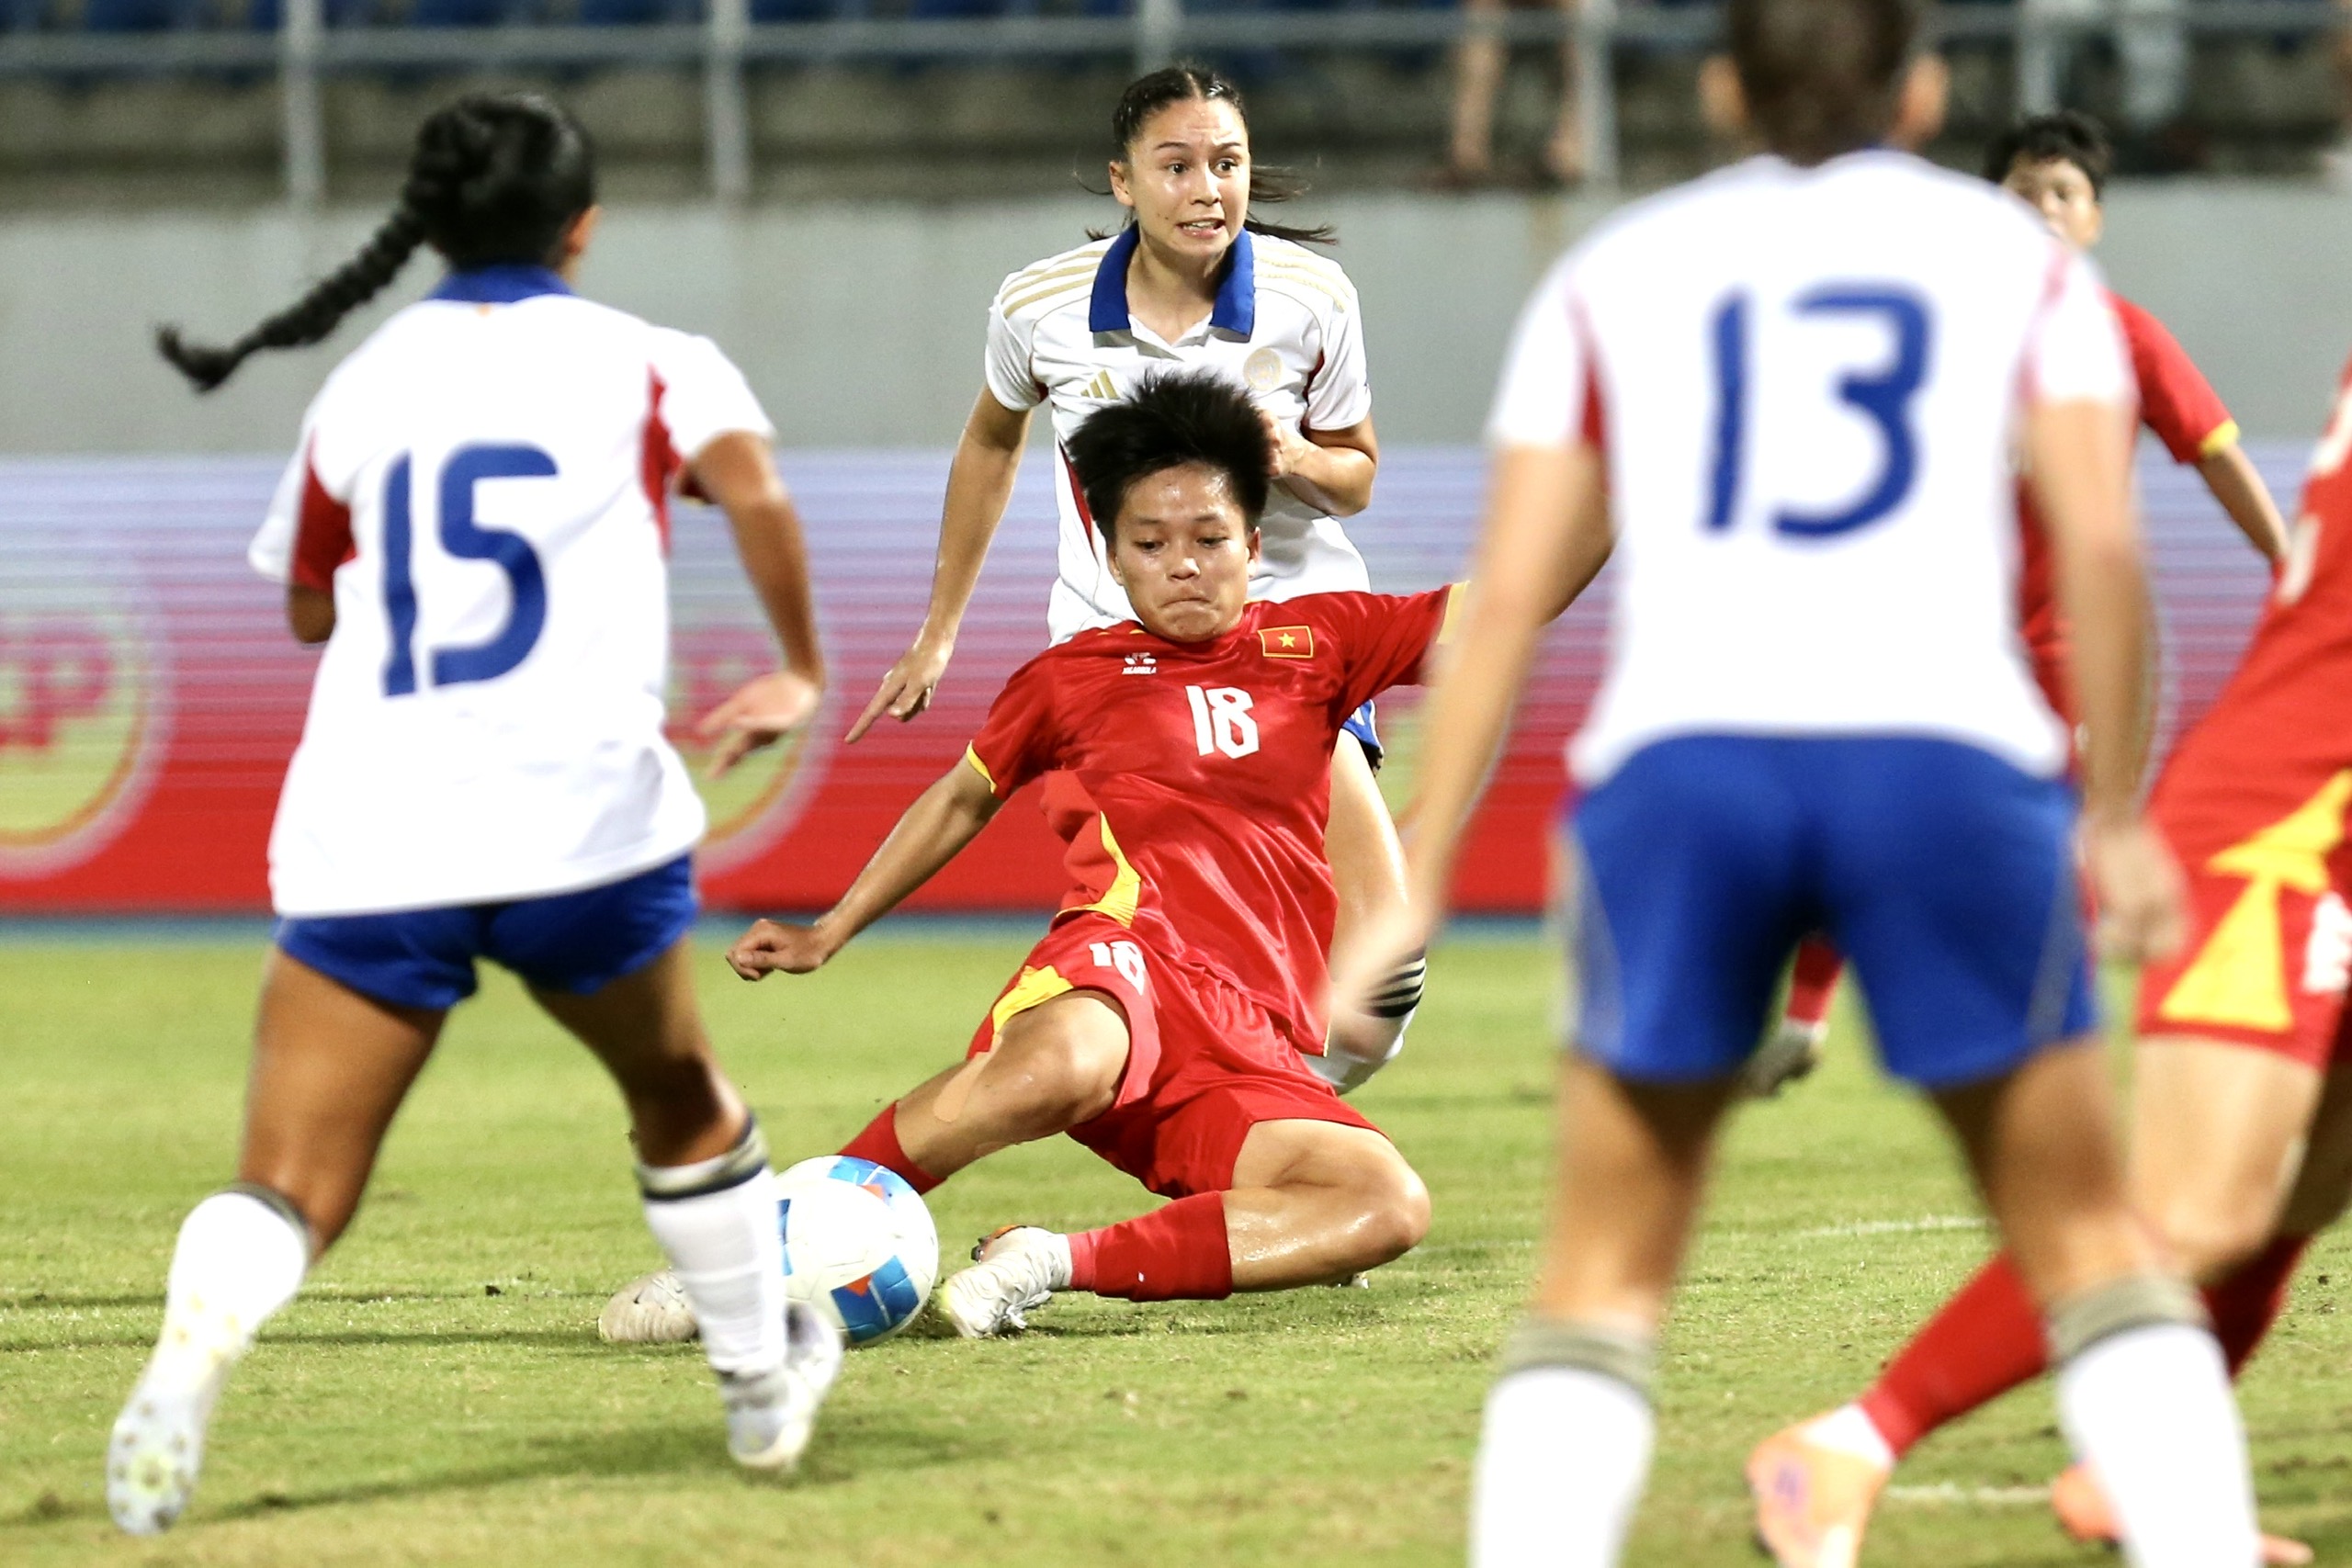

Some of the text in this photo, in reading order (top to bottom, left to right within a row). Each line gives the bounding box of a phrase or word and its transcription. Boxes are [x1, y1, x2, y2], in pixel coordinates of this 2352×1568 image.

[1704, 284, 1931, 542] 13
[381, 441, 558, 696] 15
[1185, 685, 1260, 760] 18
[1088, 941, 1147, 997] 18
